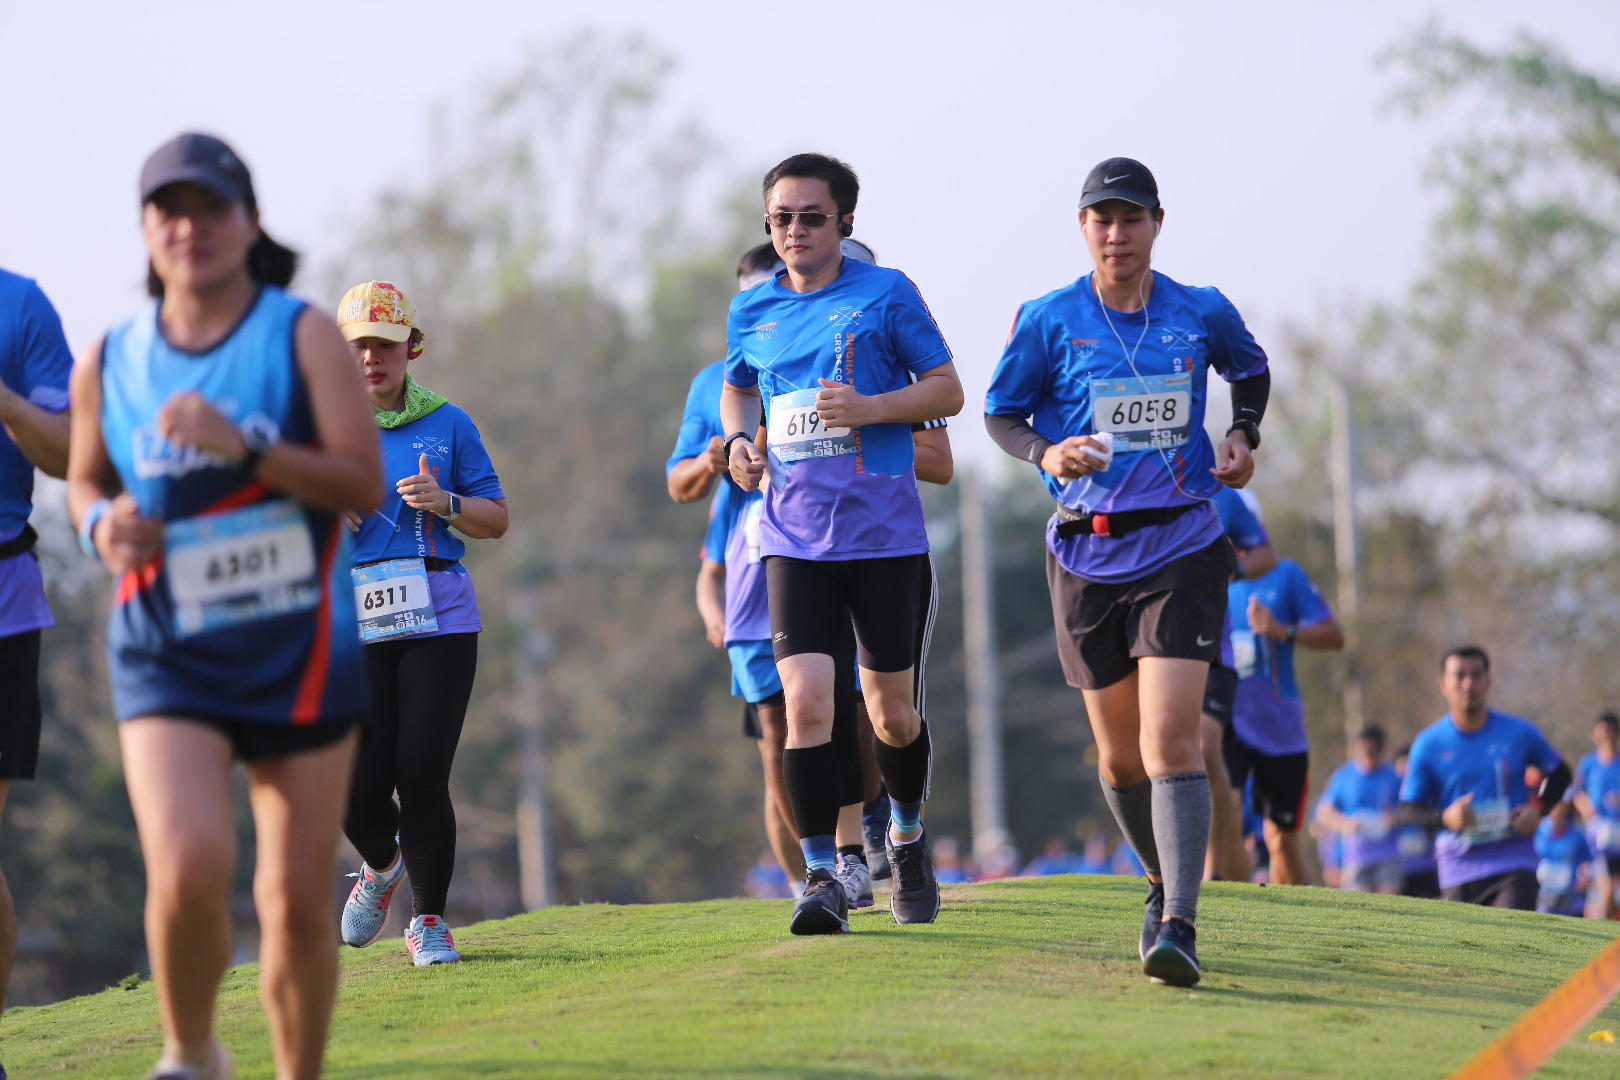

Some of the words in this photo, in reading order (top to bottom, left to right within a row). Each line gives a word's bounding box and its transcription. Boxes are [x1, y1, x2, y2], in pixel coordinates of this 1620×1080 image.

[851, 310, 864, 318] XC
[1161, 335, 1174, 343] SP
[834, 332, 842, 366] CROSS
[846, 332, 855, 375] SINGHA
[1112, 398, 1177, 425] 6058
[786, 411, 828, 437] 619
[1172, 433, 1183, 445] 16
[437, 445, 449, 454] XC
[834, 443, 845, 455] 16
[414, 508, 424, 543] UNTRY
[363, 584, 407, 611] 6311
[415, 614, 427, 626] 16
